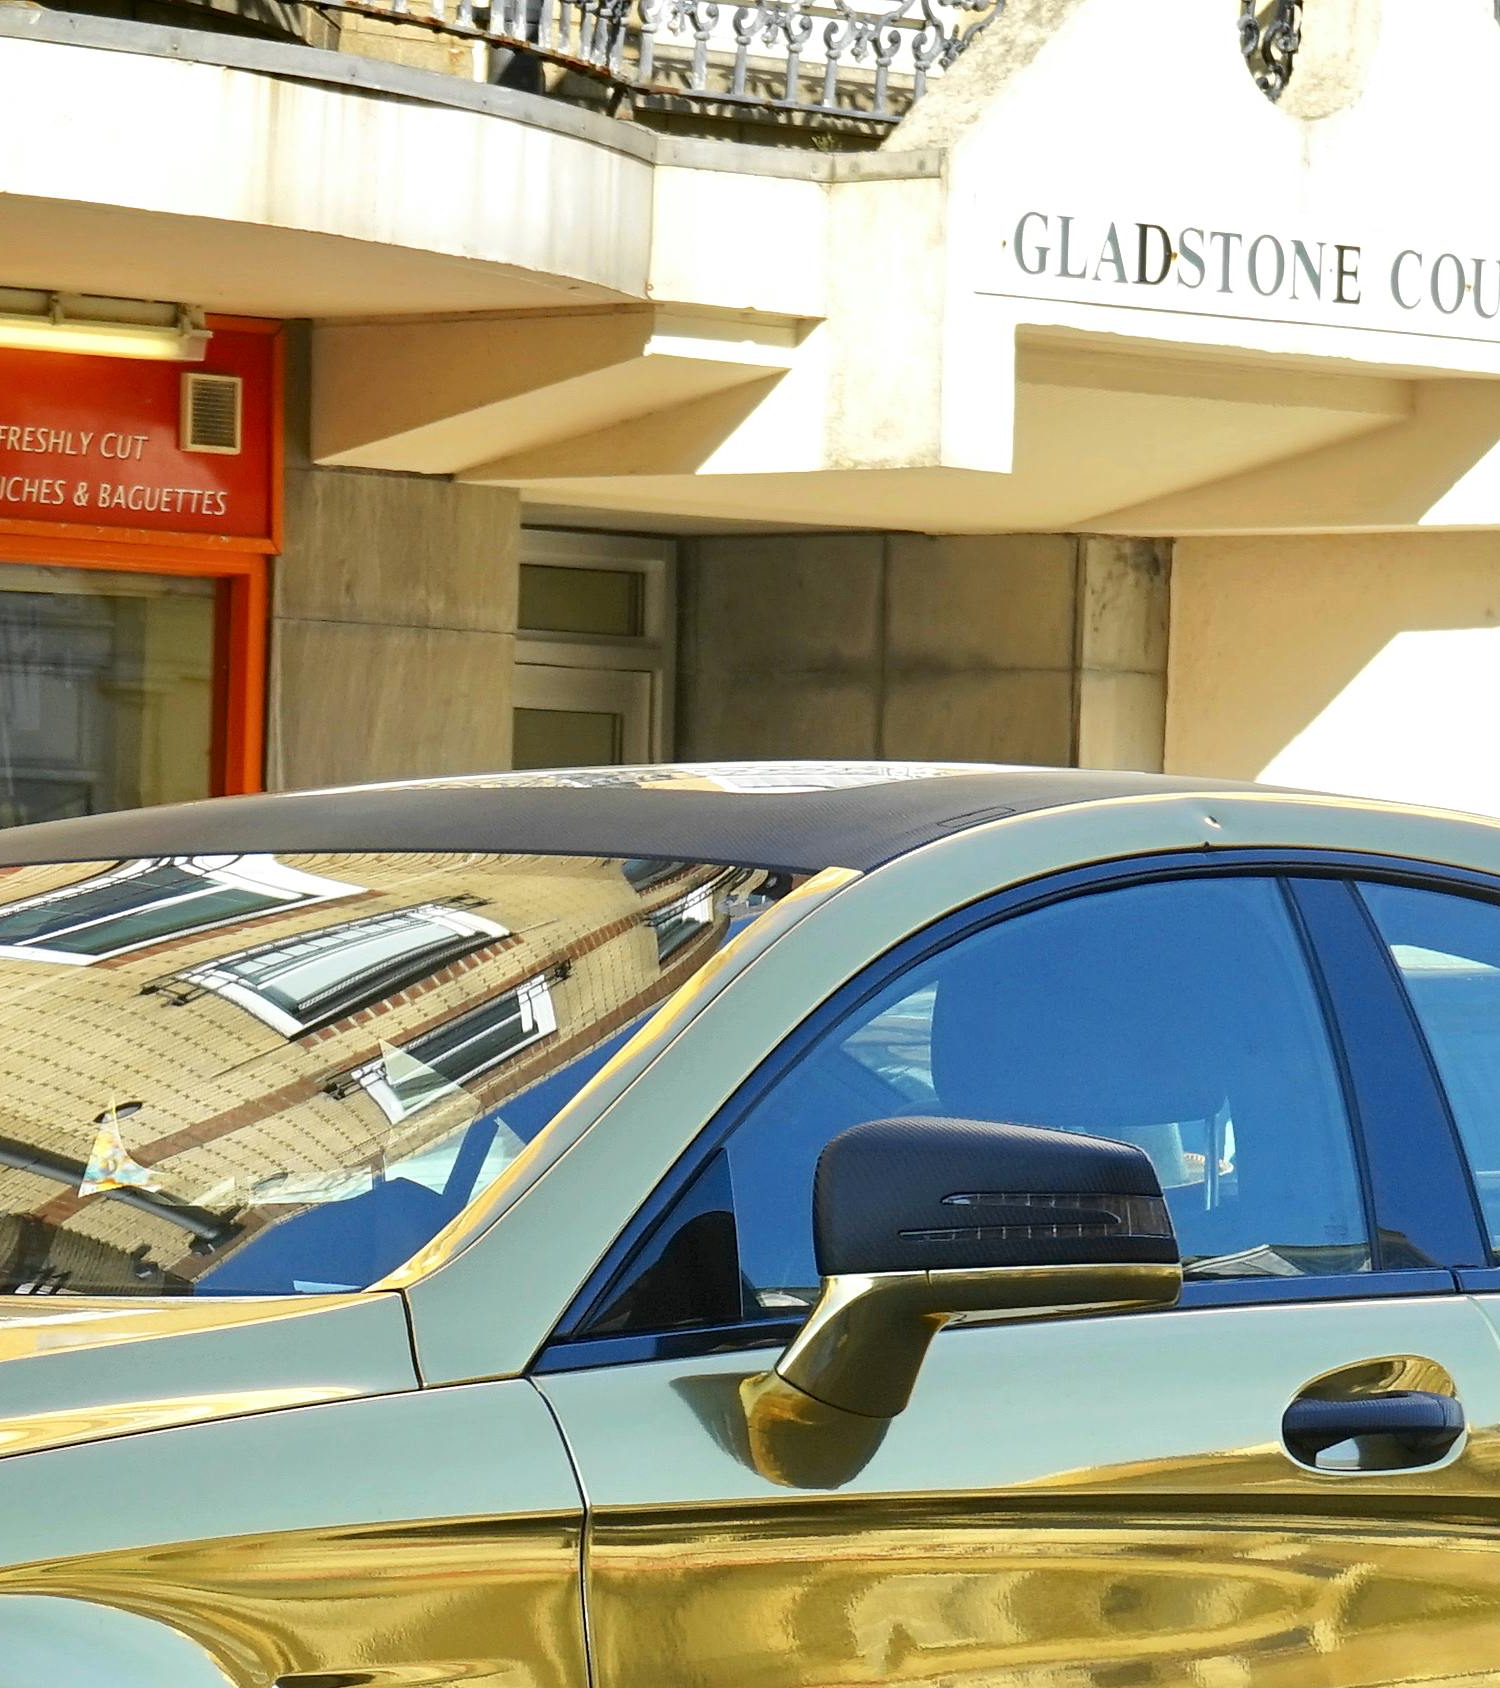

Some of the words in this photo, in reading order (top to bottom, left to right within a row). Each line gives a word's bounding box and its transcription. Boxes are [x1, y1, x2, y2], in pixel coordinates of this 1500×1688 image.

[1013, 210, 1362, 306] GLADSTONE
[100, 432, 149, 461] CUT
[72, 481, 90, 507] &
[97, 483, 228, 516] BAGUETTES
